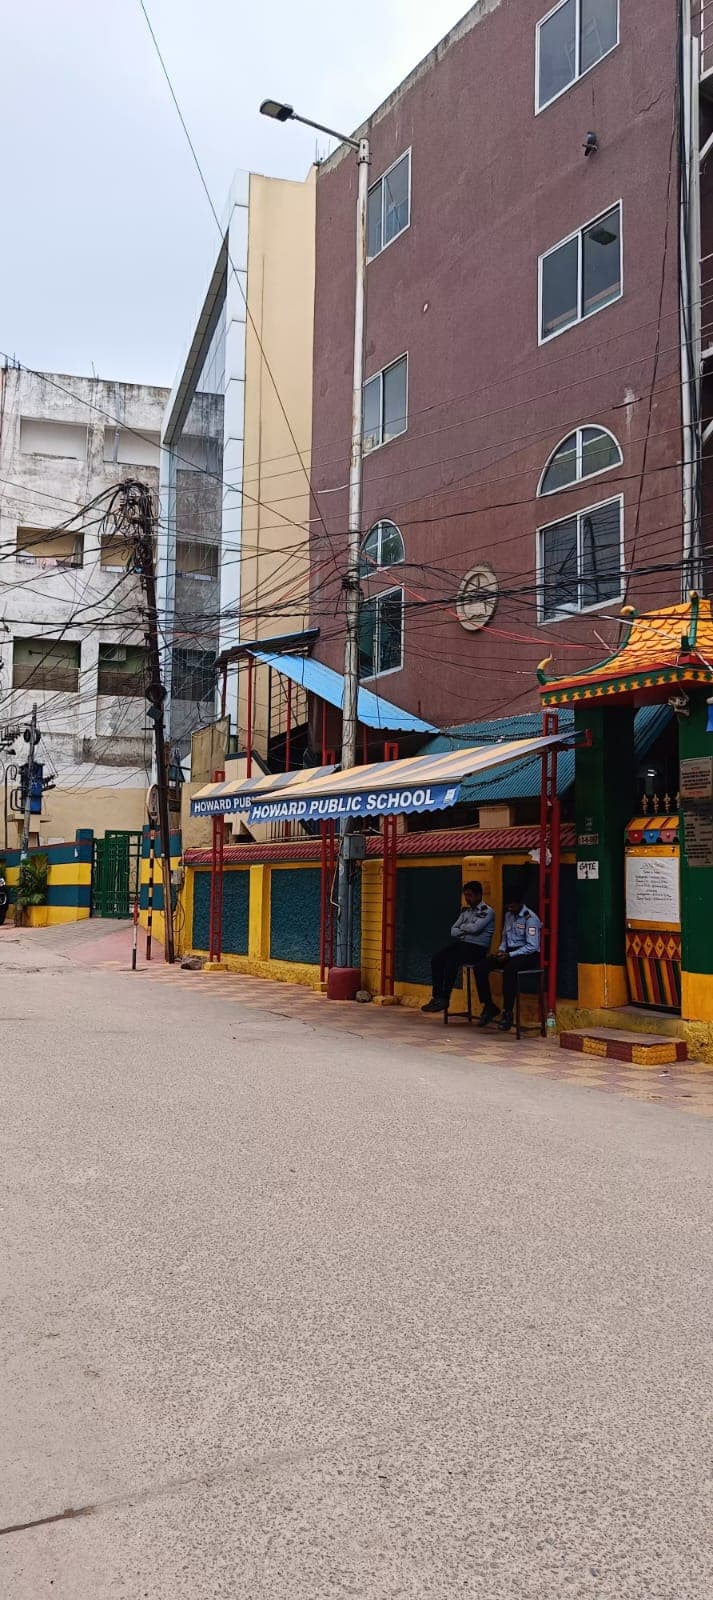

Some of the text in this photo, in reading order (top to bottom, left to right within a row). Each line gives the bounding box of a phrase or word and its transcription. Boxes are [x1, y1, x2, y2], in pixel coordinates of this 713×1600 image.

[194, 798, 231, 813] HOWARD
[251, 789, 435, 819] HOWARD PUBLIC SCHOOL
